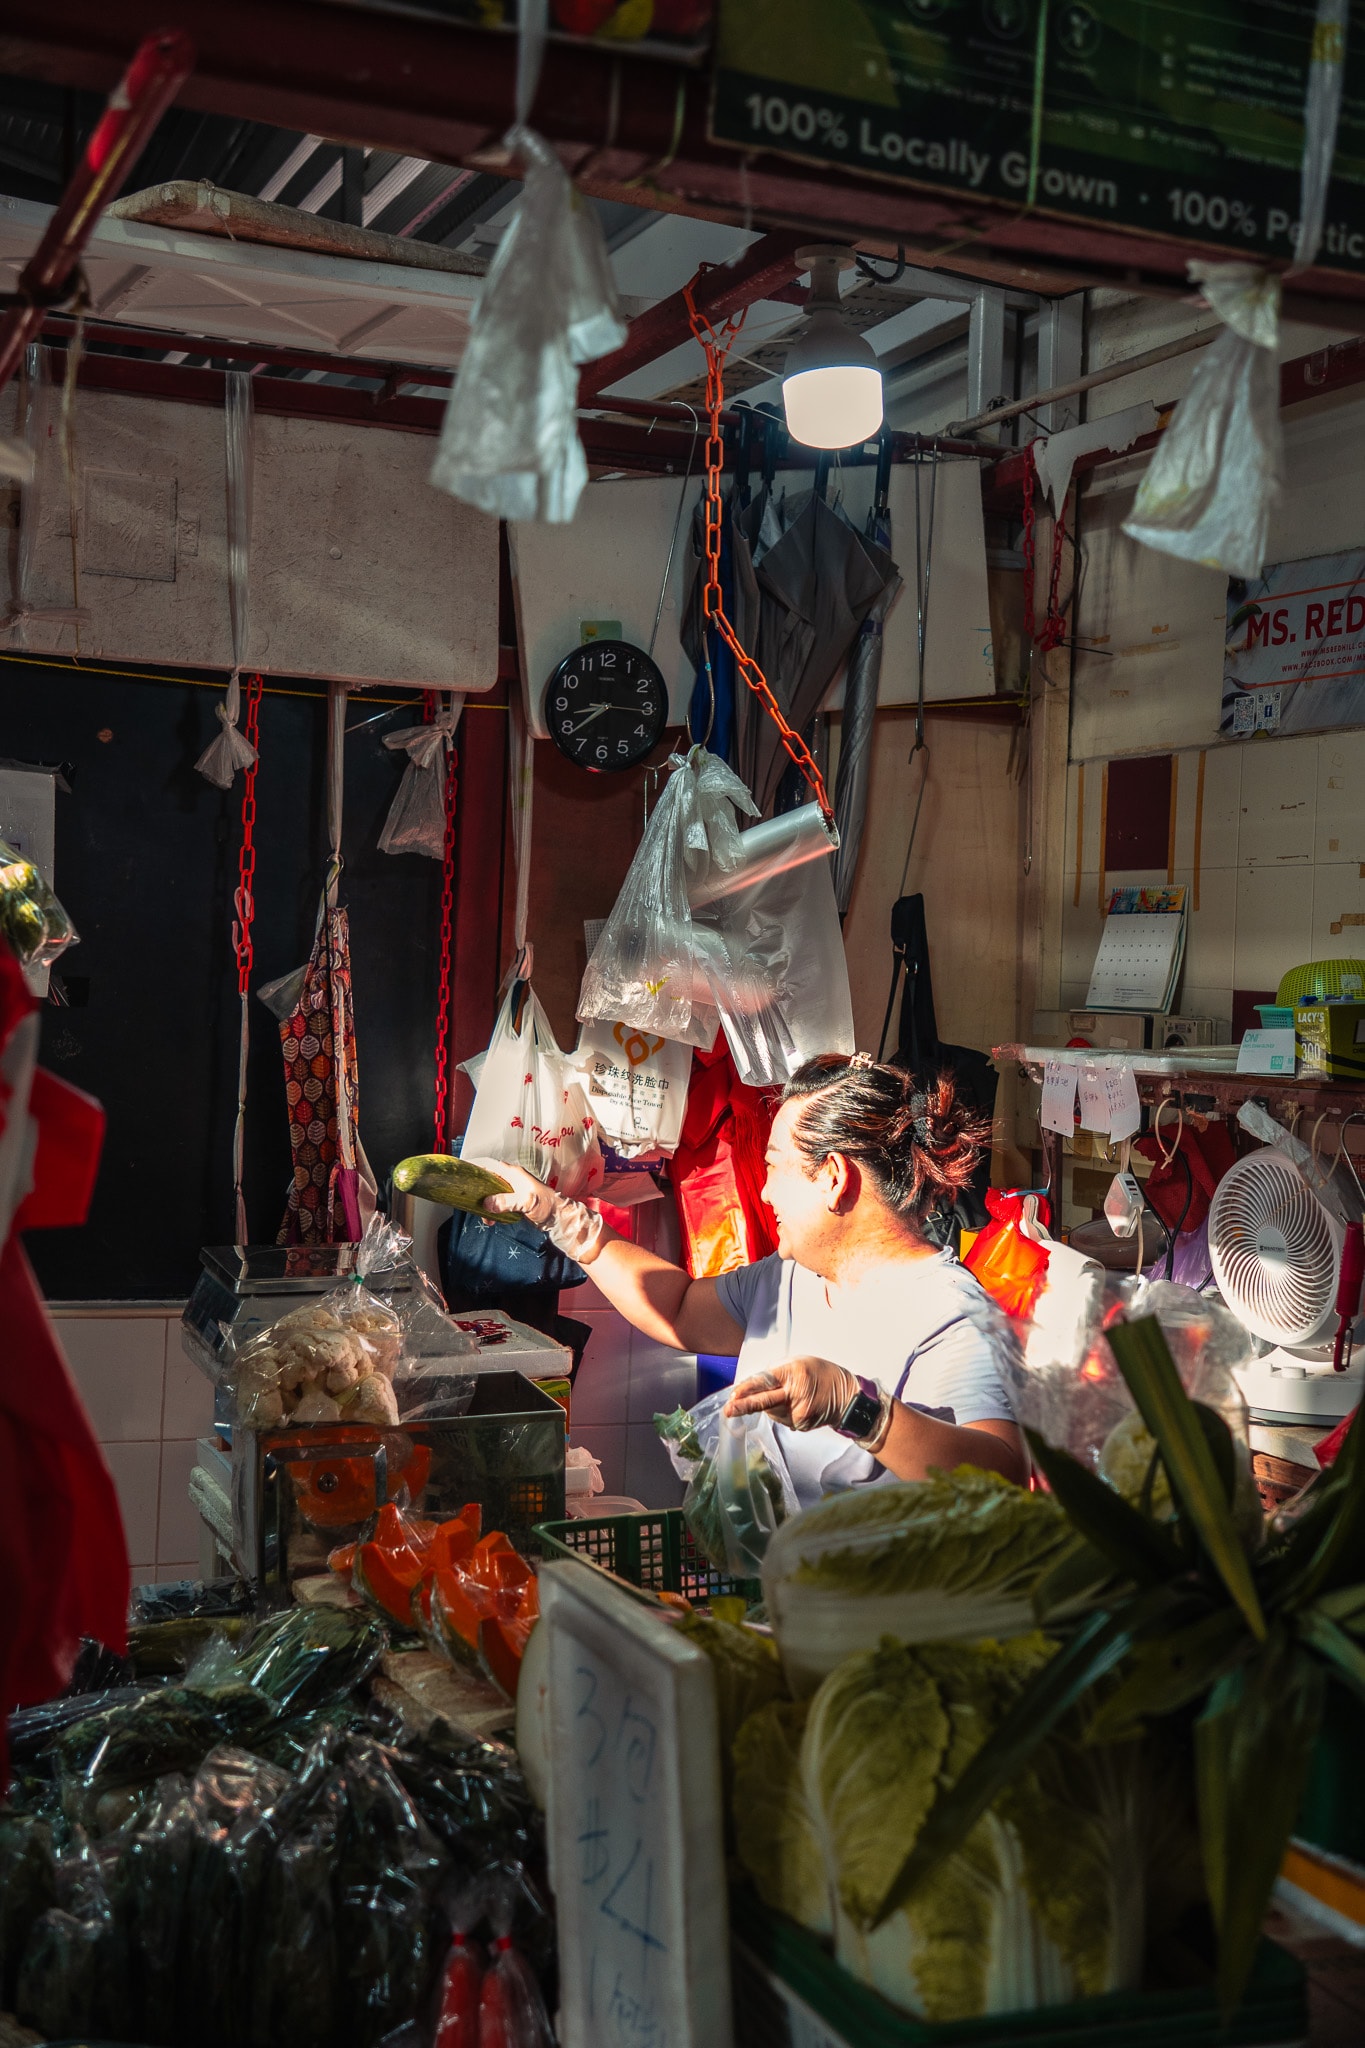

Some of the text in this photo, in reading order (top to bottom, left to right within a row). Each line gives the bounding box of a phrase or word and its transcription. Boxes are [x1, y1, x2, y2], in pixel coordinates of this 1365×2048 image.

[744, 91, 1365, 260] 100% Locally Gown 100% Petic
[1246, 595, 1365, 649] MS. RED
[581, 657, 593, 672] 11
[600, 653, 617, 668] 12
[626, 660, 631, 673] 1
[562, 675, 579, 689] 10
[636, 679, 649, 693] 2
[556, 697, 568, 711] 9
[642, 702, 653, 716] 3
[561, 720, 574, 735] 8
[634, 724, 645, 737] 4
[576, 738, 588, 752] 7
[596, 745, 608, 760] 6
[617, 740, 629, 754] 5
[1297, 1011, 1325, 1024] LACY'S
[1302, 1042, 1321, 1062] 300
[594, 1062, 670, 1090] 珍珠纹洗脸巾
[591, 1086, 627, 1099] Disposable
[627, 1094, 642, 1104] Fce
[642, 1099, 664, 1109] Towel
[531, 1125, 575, 1148] Tha ou
